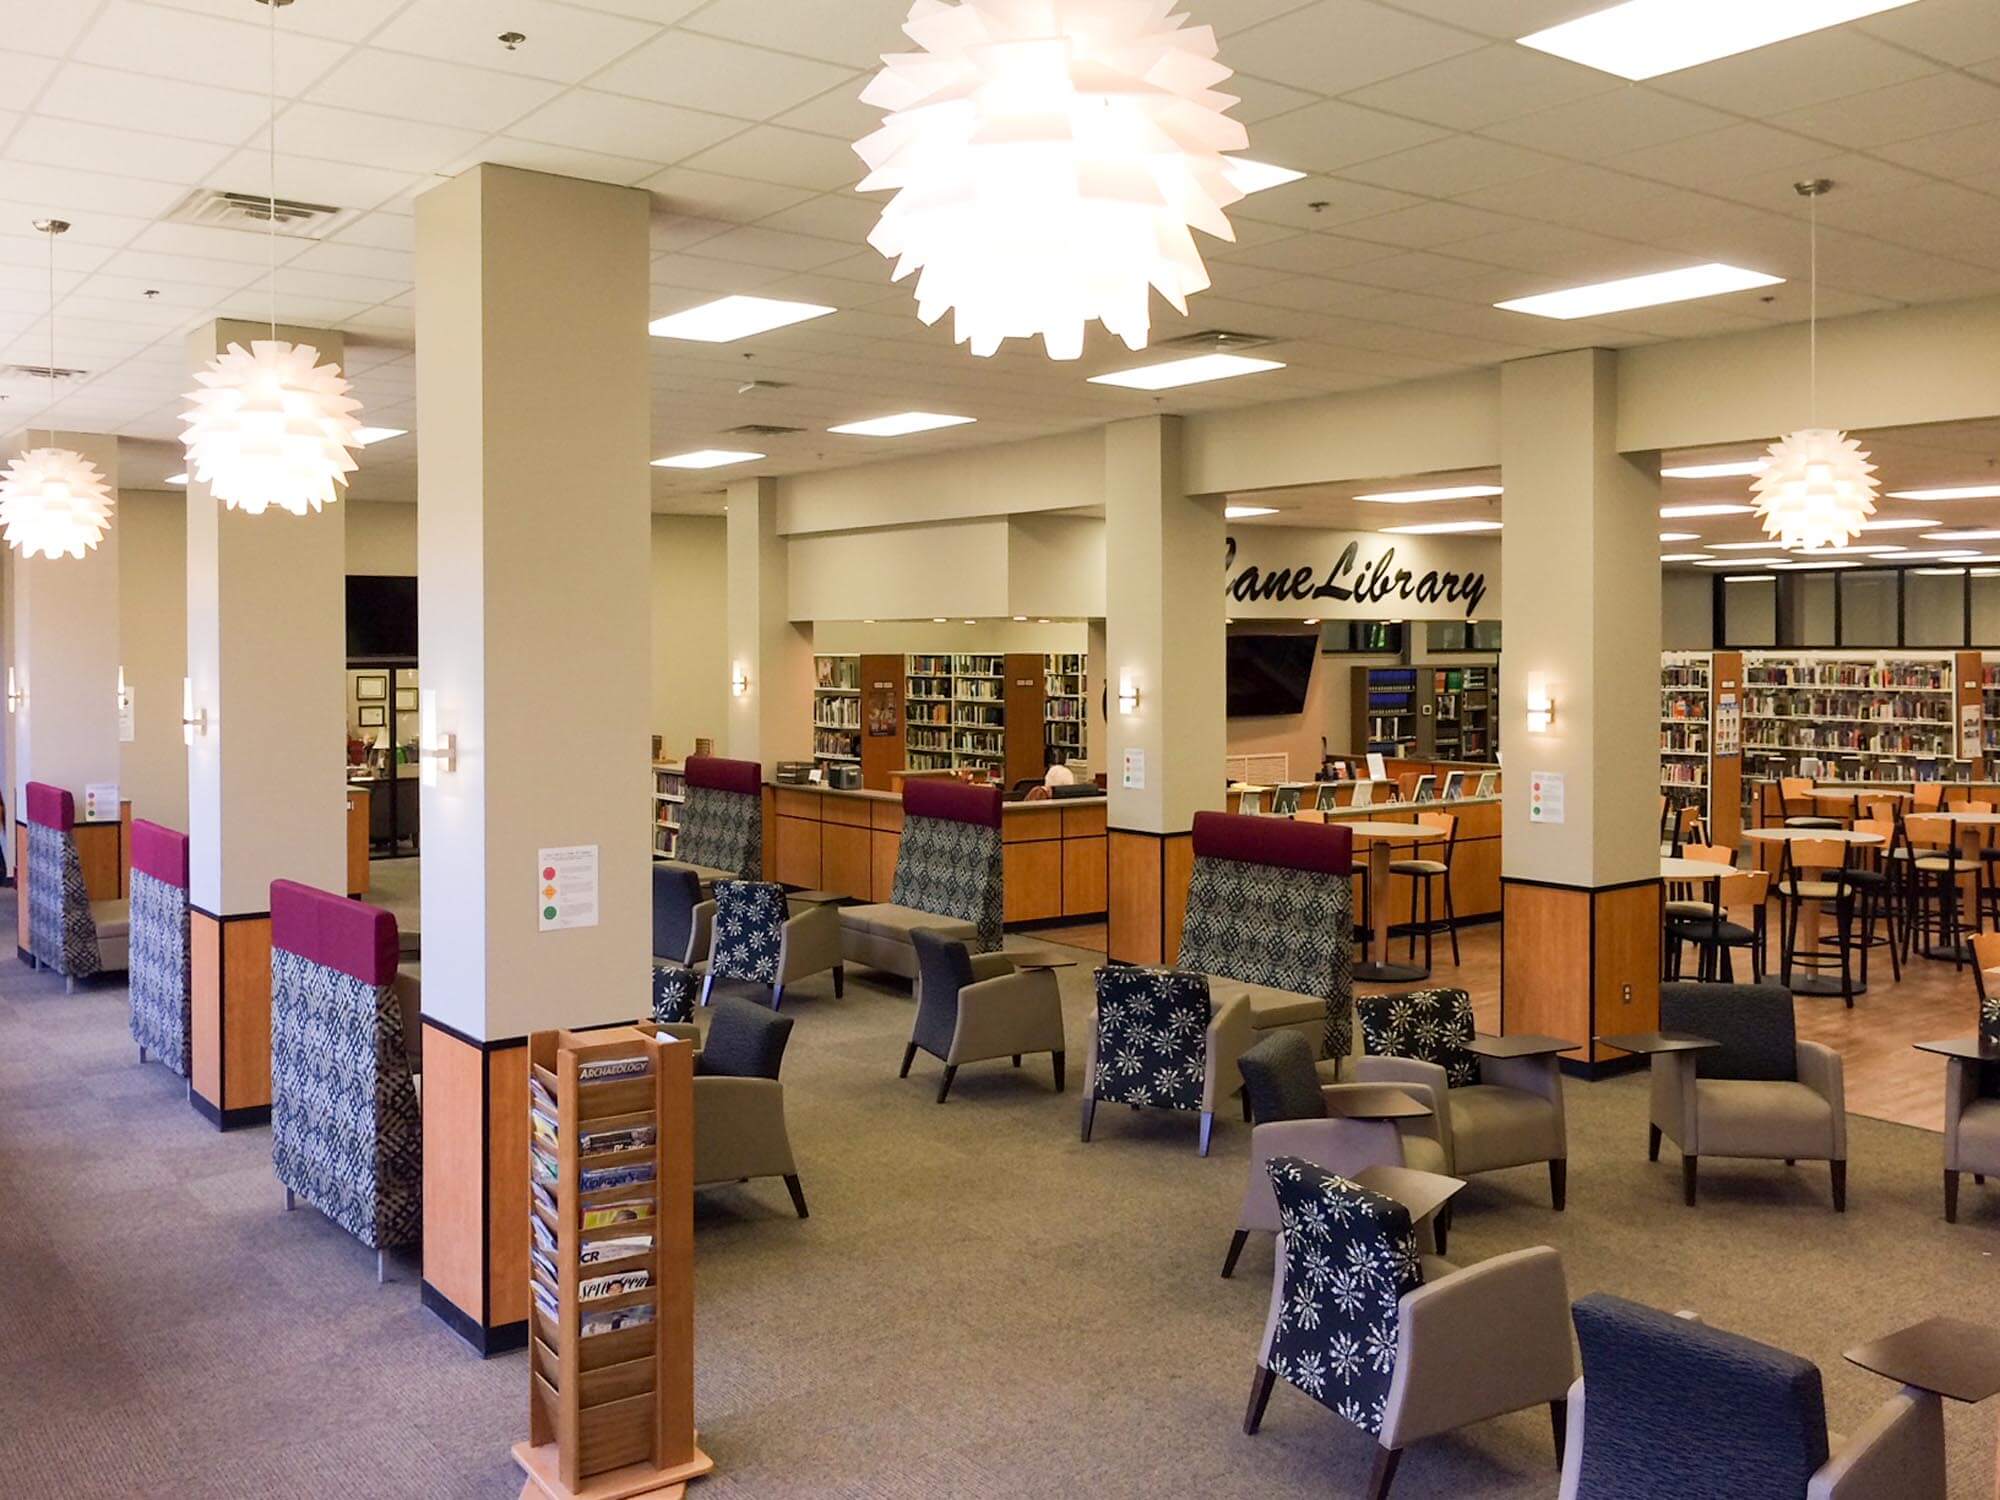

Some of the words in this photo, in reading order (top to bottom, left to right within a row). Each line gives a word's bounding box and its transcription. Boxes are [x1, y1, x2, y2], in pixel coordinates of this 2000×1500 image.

[1312, 540, 1487, 617] Library
[580, 1063, 648, 1079] ARCHAEOLOGY
[581, 1251, 600, 1263] CR
